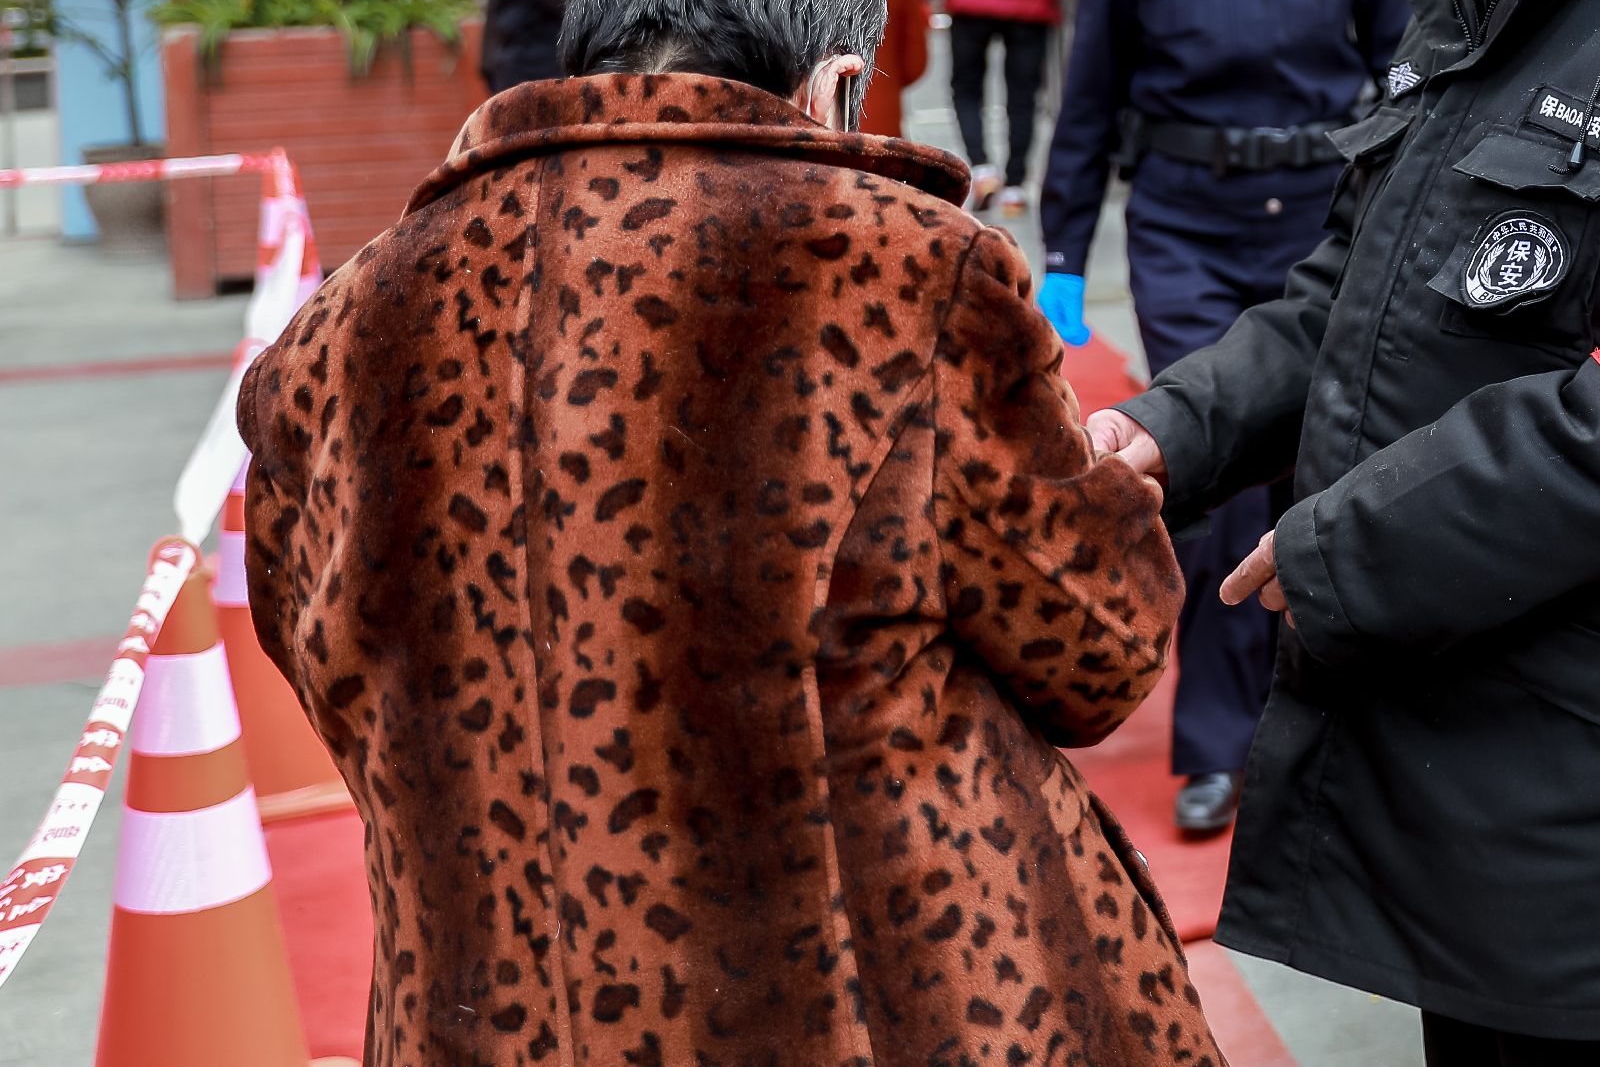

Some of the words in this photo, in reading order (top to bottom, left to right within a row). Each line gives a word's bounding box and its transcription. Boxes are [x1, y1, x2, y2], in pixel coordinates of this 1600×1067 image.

[1492, 222, 1555, 247] 中华人民共和国
[1497, 239, 1532, 286] 保安
